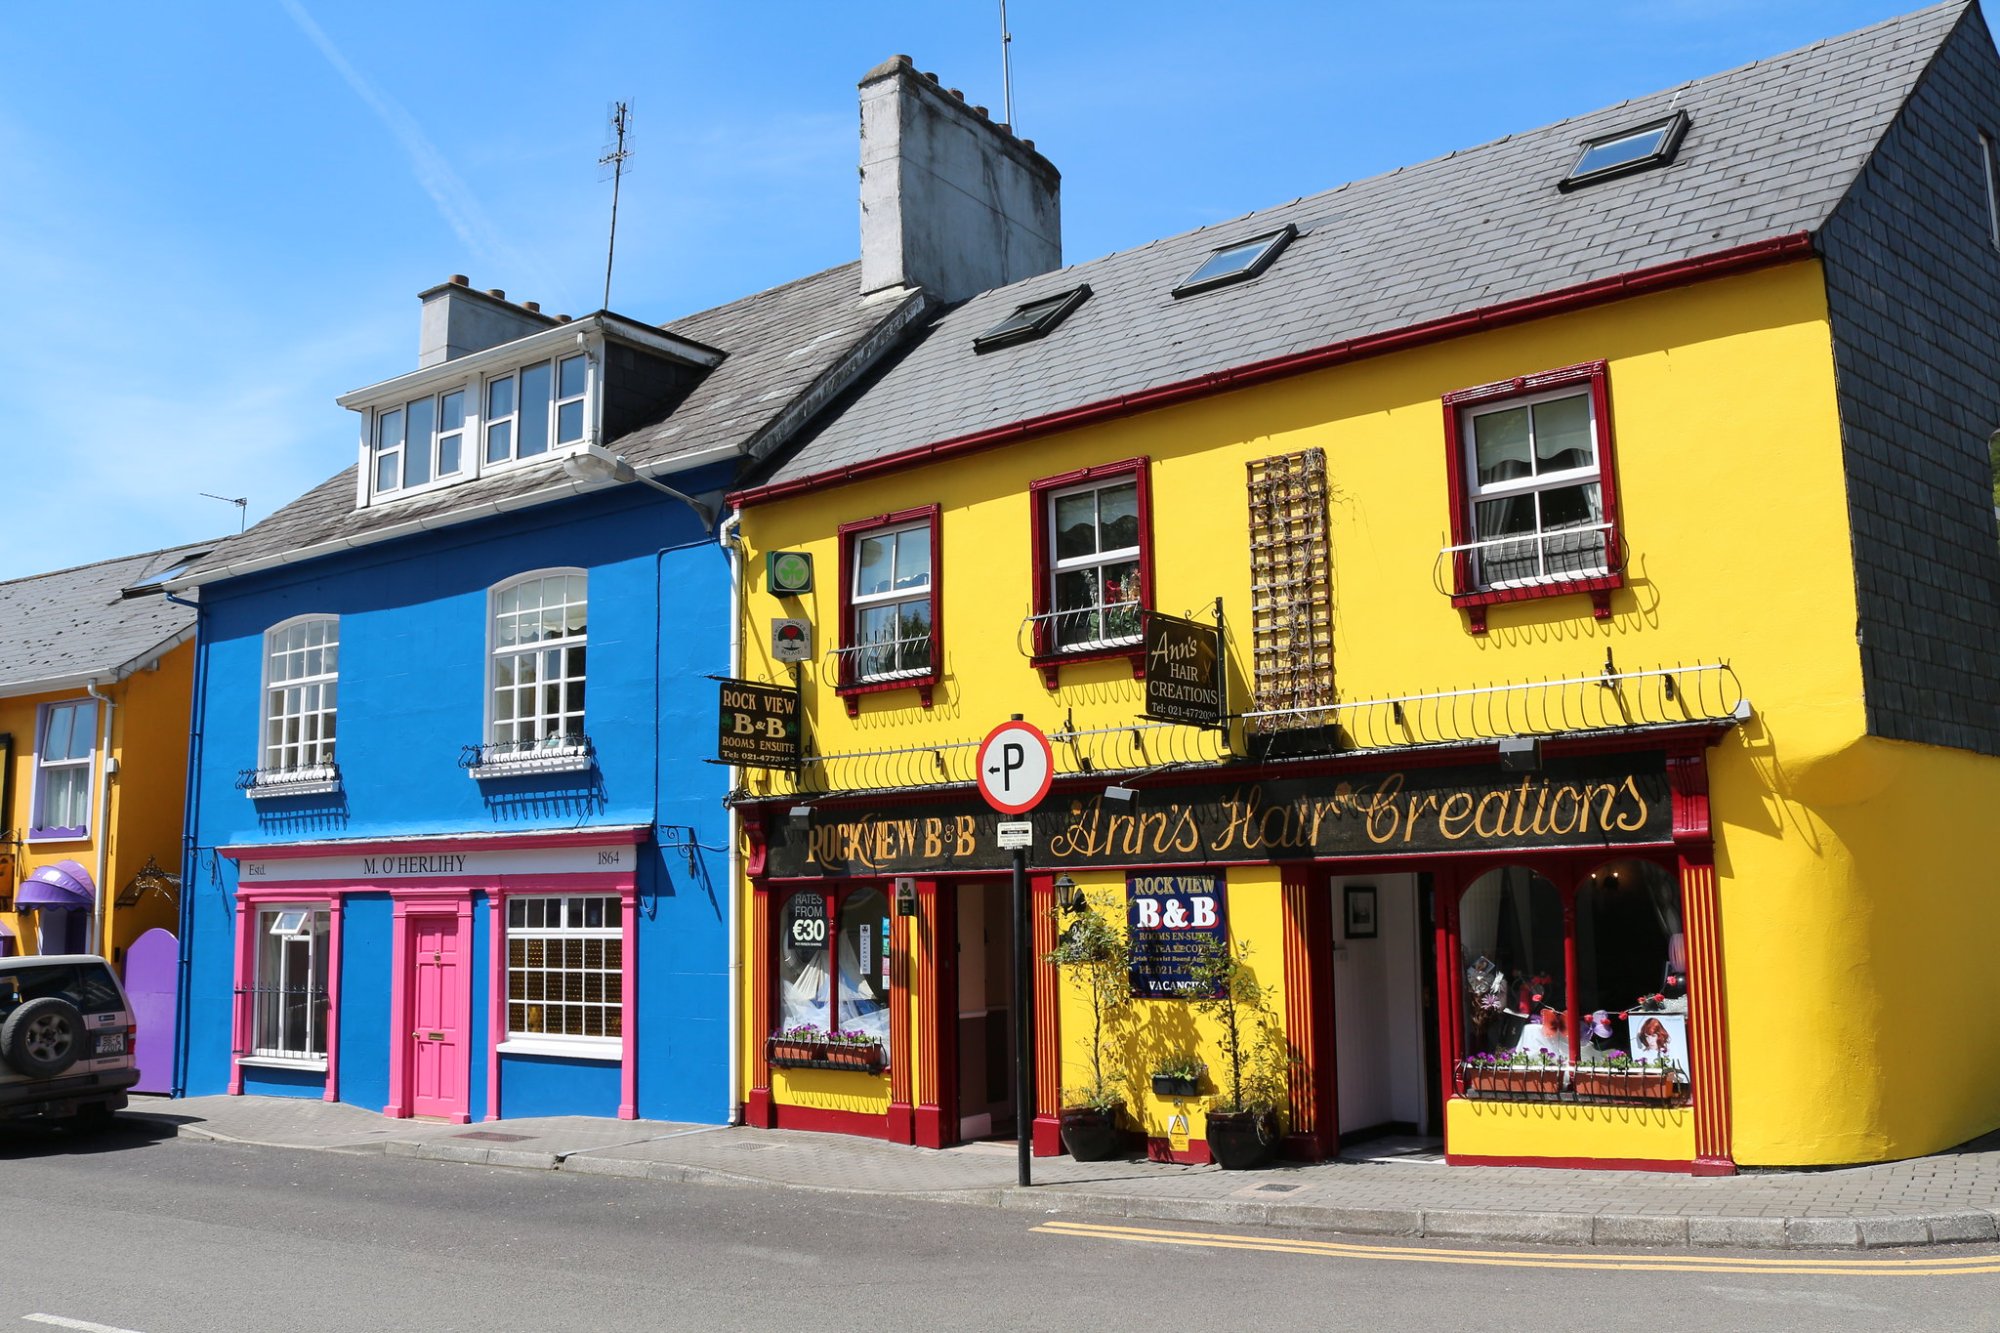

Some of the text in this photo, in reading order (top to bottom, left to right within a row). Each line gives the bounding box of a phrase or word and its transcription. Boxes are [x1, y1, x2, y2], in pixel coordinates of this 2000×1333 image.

[1151, 631, 1197, 671] Ann's
[1170, 662, 1199, 682] HAIR
[723, 690, 795, 715] ROCK VIEW
[1150, 680, 1218, 705] CREATIONS
[733, 713, 786, 738] B&B
[722, 736, 795, 753] ROOMS ENSUITE
[1004, 743, 1024, 791] P
[1051, 773, 1648, 857] Ann's Hair Creations
[597, 851, 619, 865] 1864
[1135, 876, 1215, 895] ROCK VIEW
[795, 894, 822, 905] RATES
[795, 906, 822, 917] FROM
[1136, 896, 1218, 930] B&B
[793, 919, 825, 941] €30
